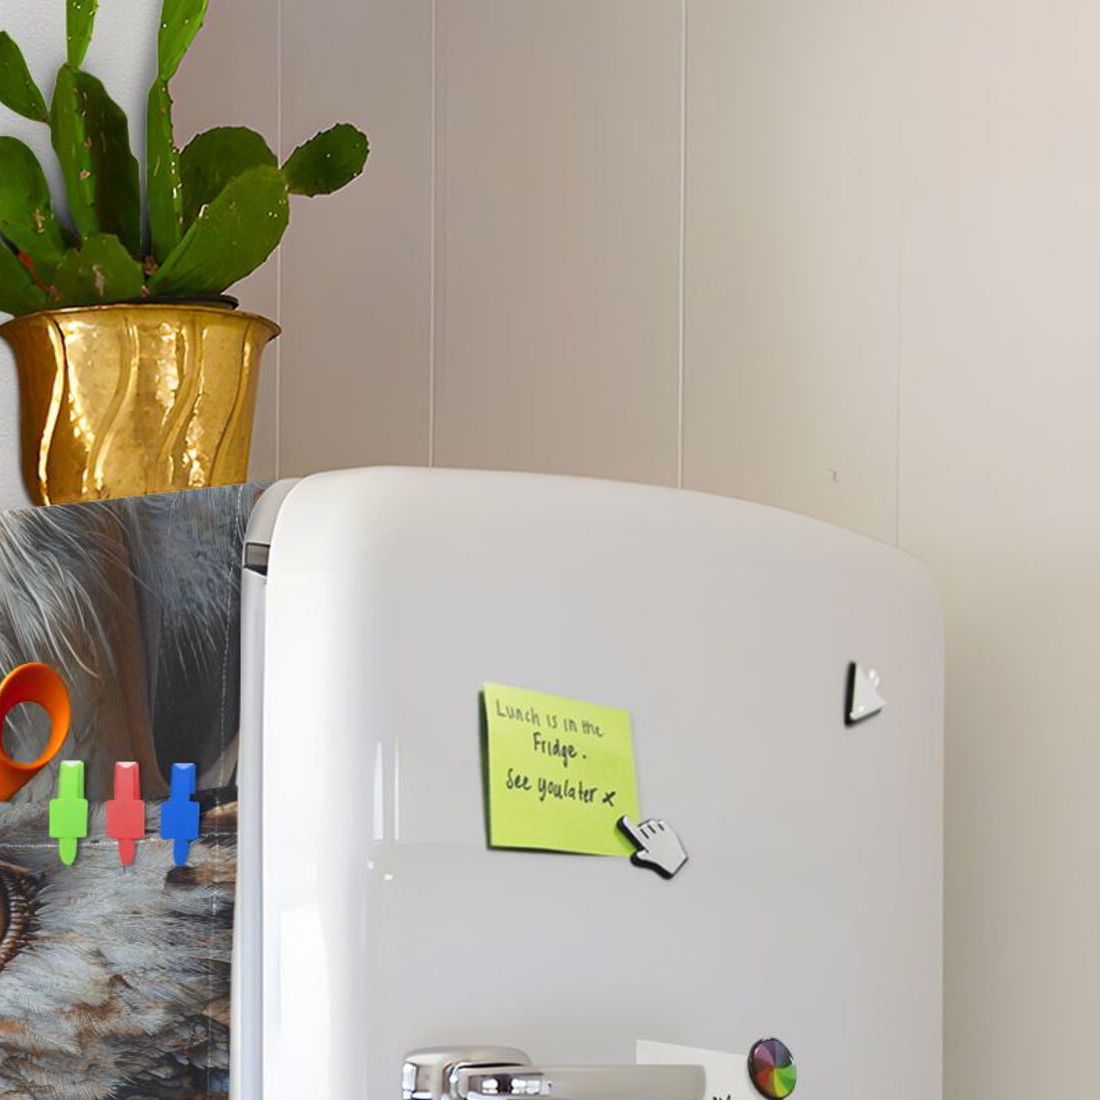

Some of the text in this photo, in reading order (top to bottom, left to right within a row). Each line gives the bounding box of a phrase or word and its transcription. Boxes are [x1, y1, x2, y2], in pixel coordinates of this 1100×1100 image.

[495, 698, 605, 738] Lunch is in the
[505, 767, 533, 792] See
